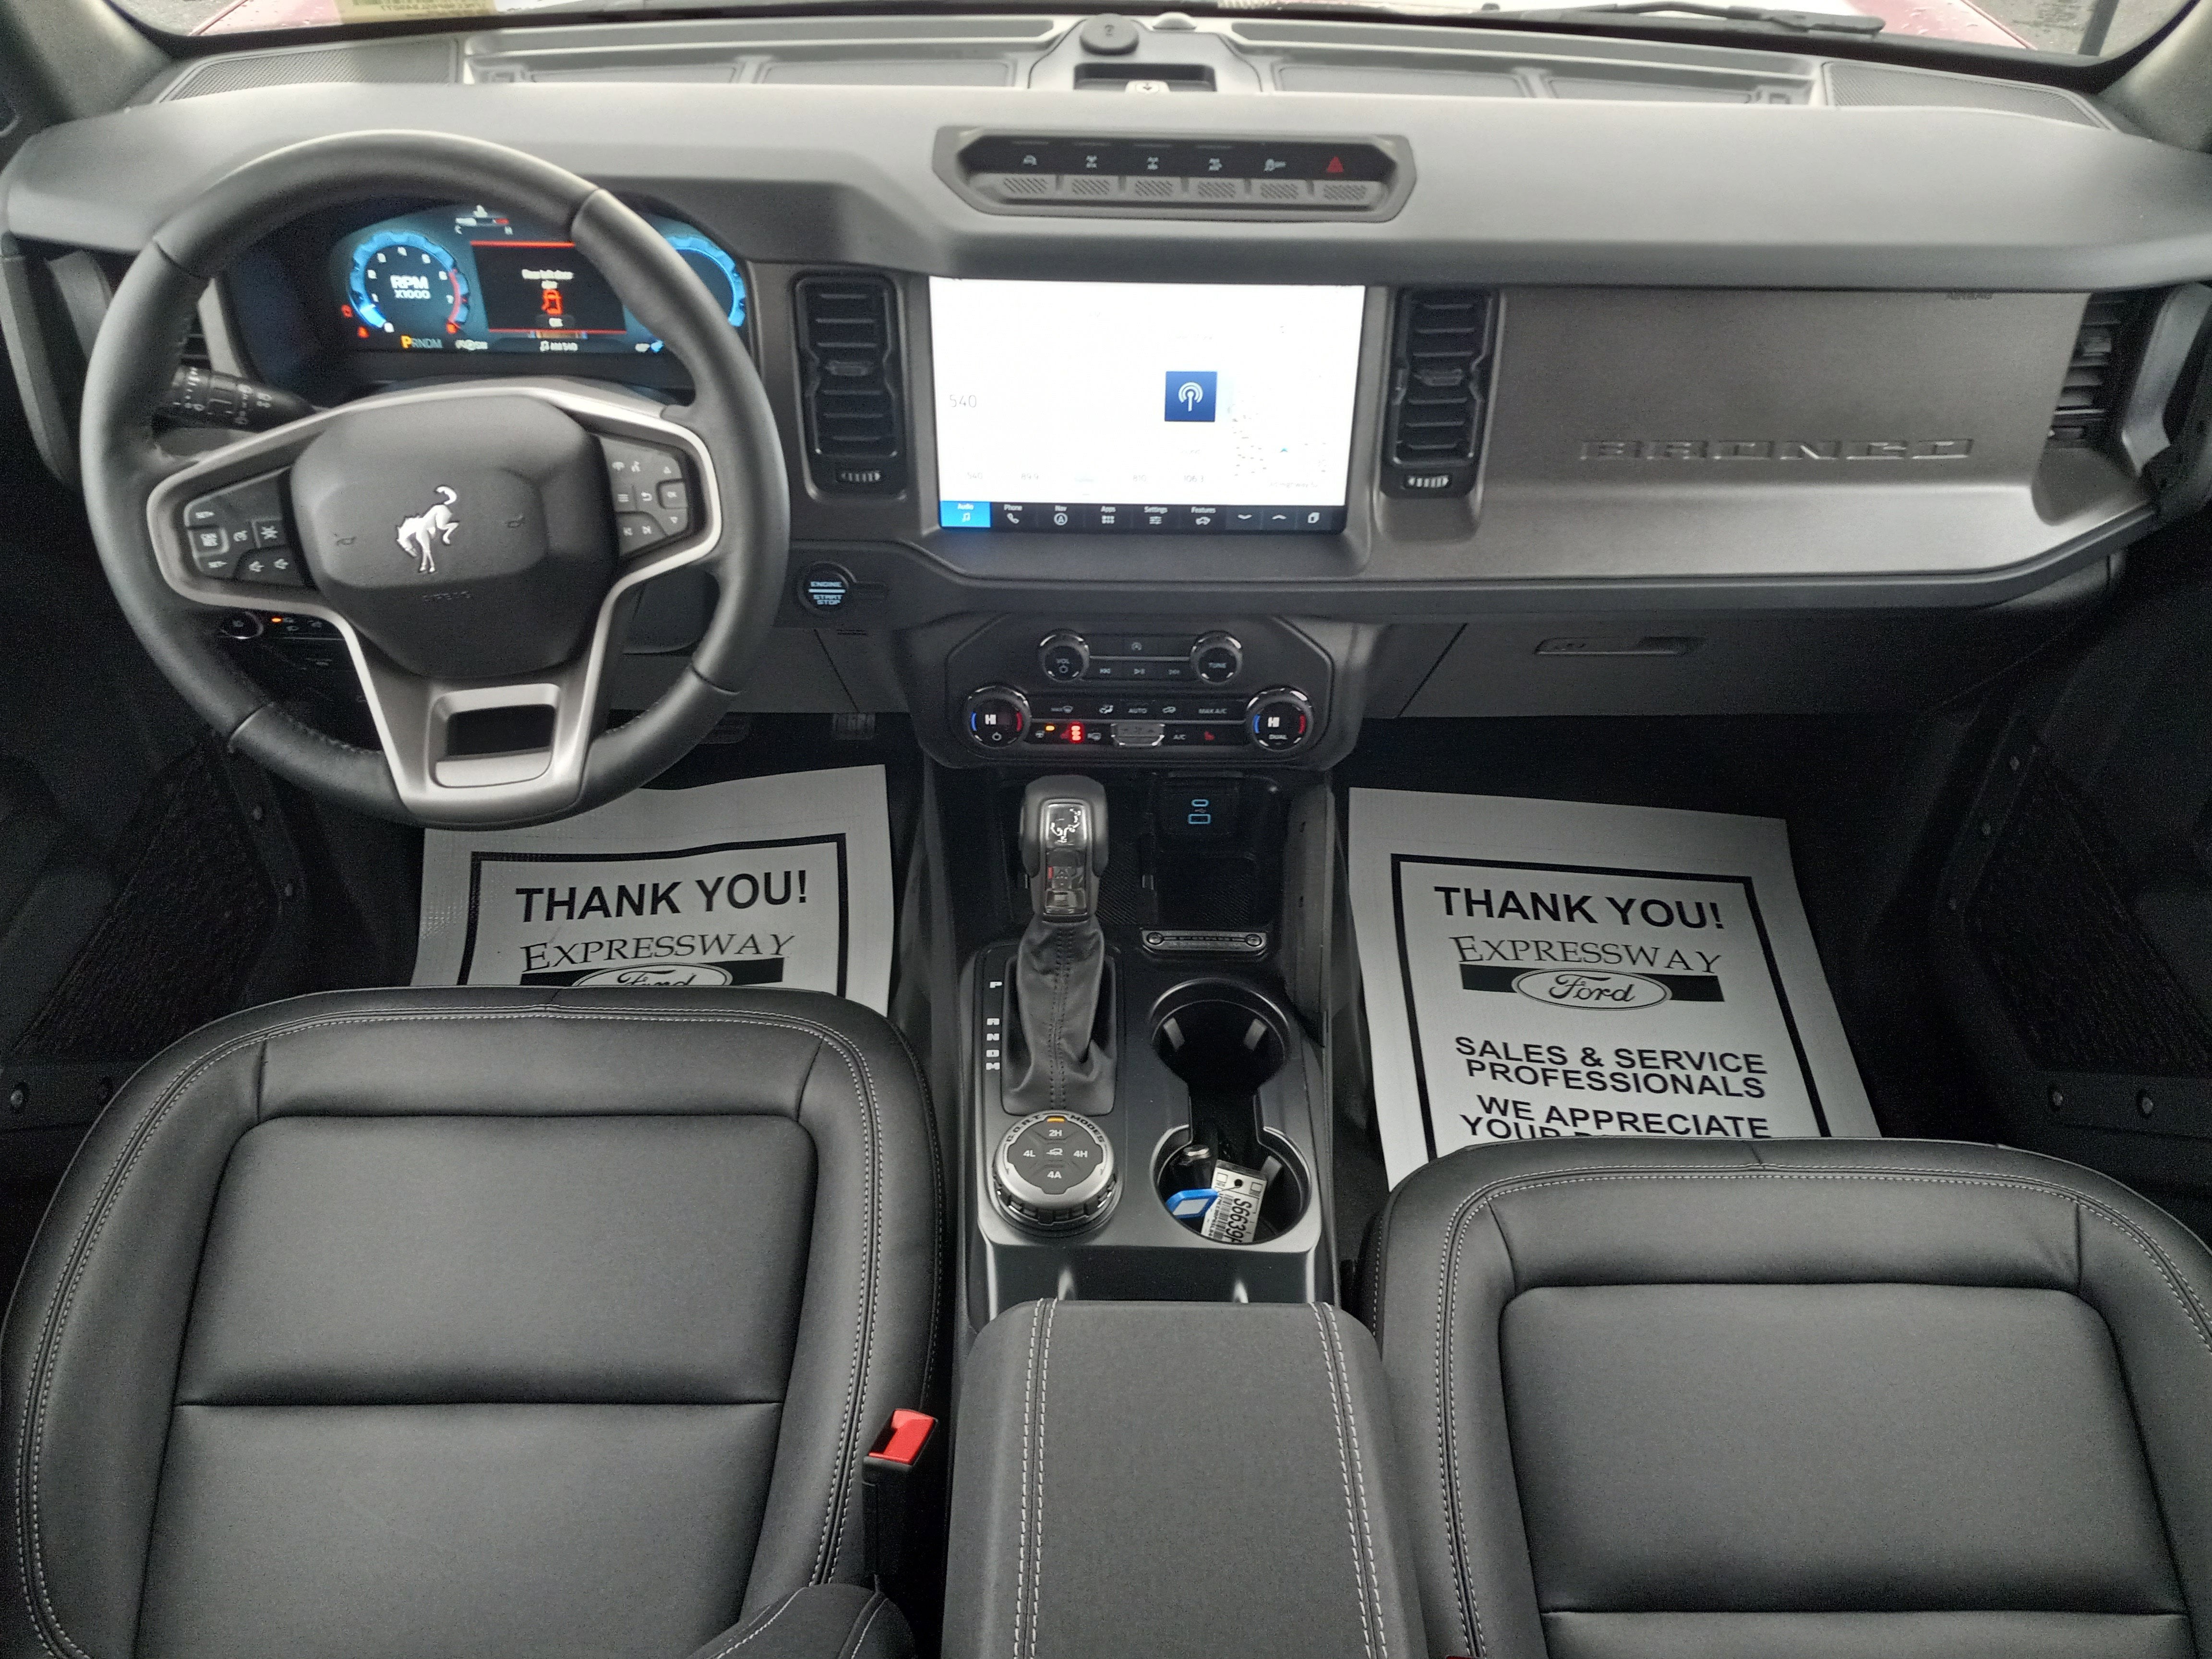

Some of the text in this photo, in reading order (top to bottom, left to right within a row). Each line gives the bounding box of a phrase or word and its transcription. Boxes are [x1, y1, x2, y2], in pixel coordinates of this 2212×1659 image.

[390, 275, 429, 289] RPM
[949, 394, 978, 409] 540
[515, 870, 808, 923] THANK YOU!
[1434, 886, 1725, 930] THANK YOU!
[520, 933, 795, 973] EXPRESSWAY
[1449, 936, 1722, 974] EXPRESSWAY
[1548, 974, 1636, 1003] Ford
[1455, 1036, 1768, 1075] SALES & SERVICE
[1465, 1058, 1766, 1099] PROFESSIONALS
[1070, 1114, 1105, 1143] MODES
[1476, 1094, 1772, 1139] WE APPRECIATE
[1046, 1171, 1062, 1179] 4A
